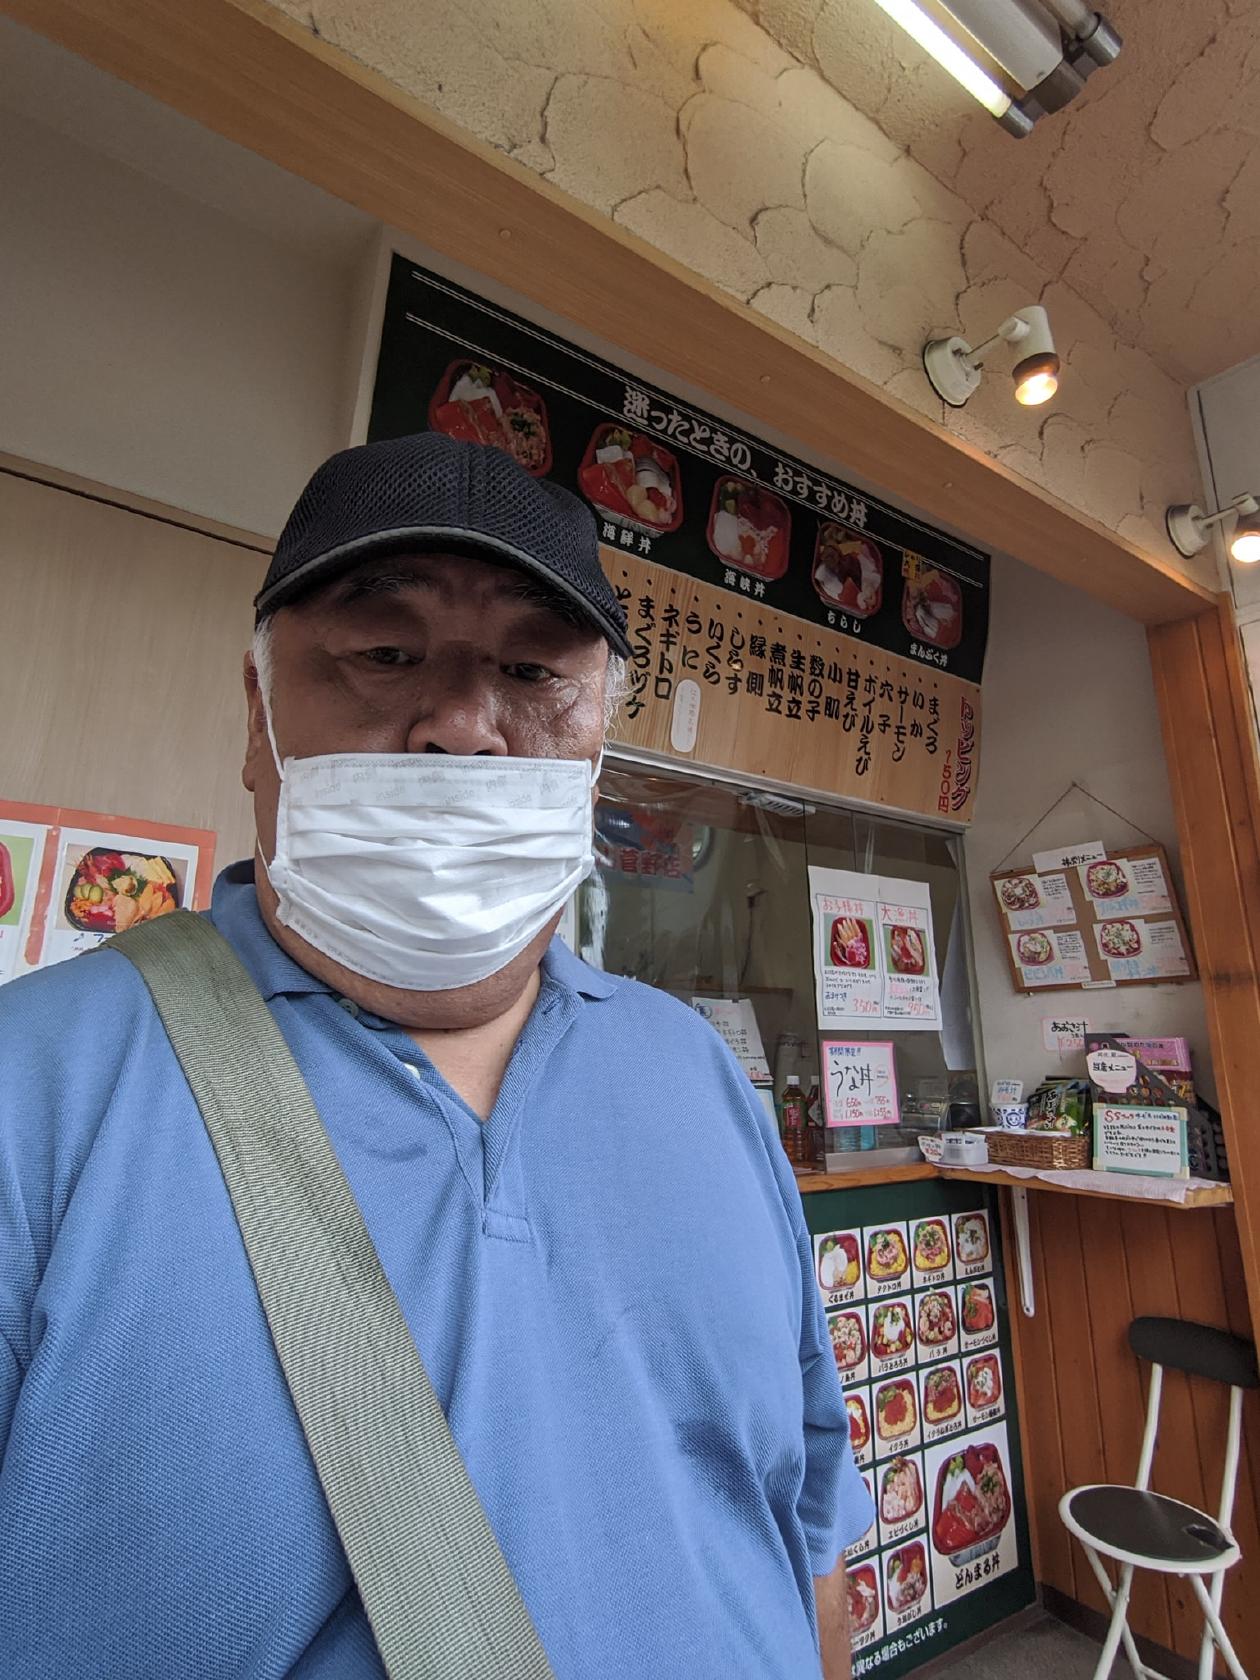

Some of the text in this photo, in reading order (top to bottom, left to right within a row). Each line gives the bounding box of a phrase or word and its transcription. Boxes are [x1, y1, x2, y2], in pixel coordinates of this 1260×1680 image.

[603, 522, 652, 554] 海鮮丼
[654, 603, 680, 700] ネギトロ
[681, 611, 703, 670] うに
[703, 618, 725, 685] いくら
[827, 609, 861, 633] ちらし
[725, 625, 745, 695] しらす
[746, 633, 768, 697] 縁側
[765, 642, 787, 715] 煮帆立
[785, 649, 806, 721] 生帆立
[805, 654, 825, 722] 数の子
[824, 662, 843, 720] 小肌
[842, 667, 861, 732] 甘えび
[855, 674, 879, 776] ボイルえび
[877, 680, 894, 734] 穴子
[891, 685, 910, 761] サーモン
[910, 691, 925, 738] いか
[924, 696, 940, 754] まぐろ
[831, 1060, 873, 1096] うな丼
[955, 1552, 1000, 1590] どんまる丼
